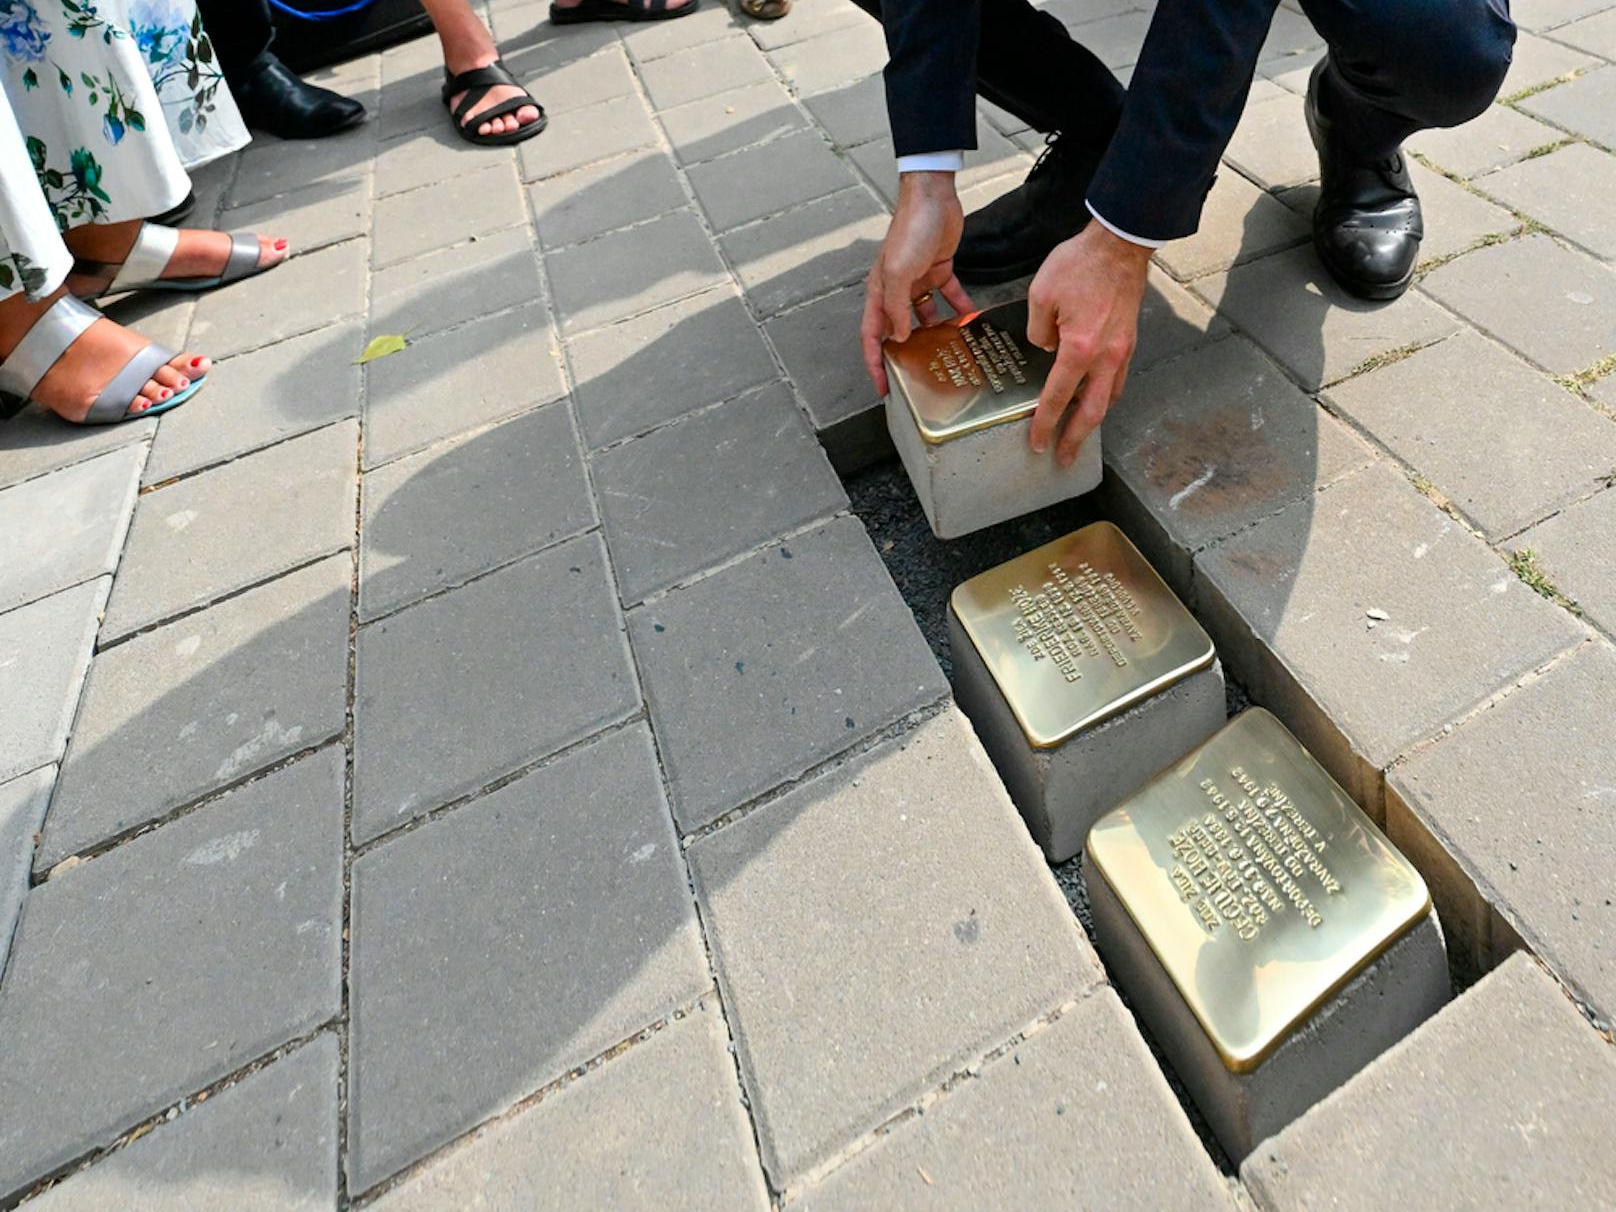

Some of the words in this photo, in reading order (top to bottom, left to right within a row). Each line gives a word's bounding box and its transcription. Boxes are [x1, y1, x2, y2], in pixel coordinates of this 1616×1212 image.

[1029, 614, 1081, 682] FRIEDERIKE
[1236, 798, 1287, 858] TEREZÍNA
[1264, 782, 1316, 841] TEREZÍNĚ
[1166, 830, 1207, 879] HOŽE
[1244, 835, 1322, 929] DEPORTOVÁNA
[1272, 816, 1340, 895] ZAVRAŽDĚNA
[1202, 873, 1257, 942] CECILIE
